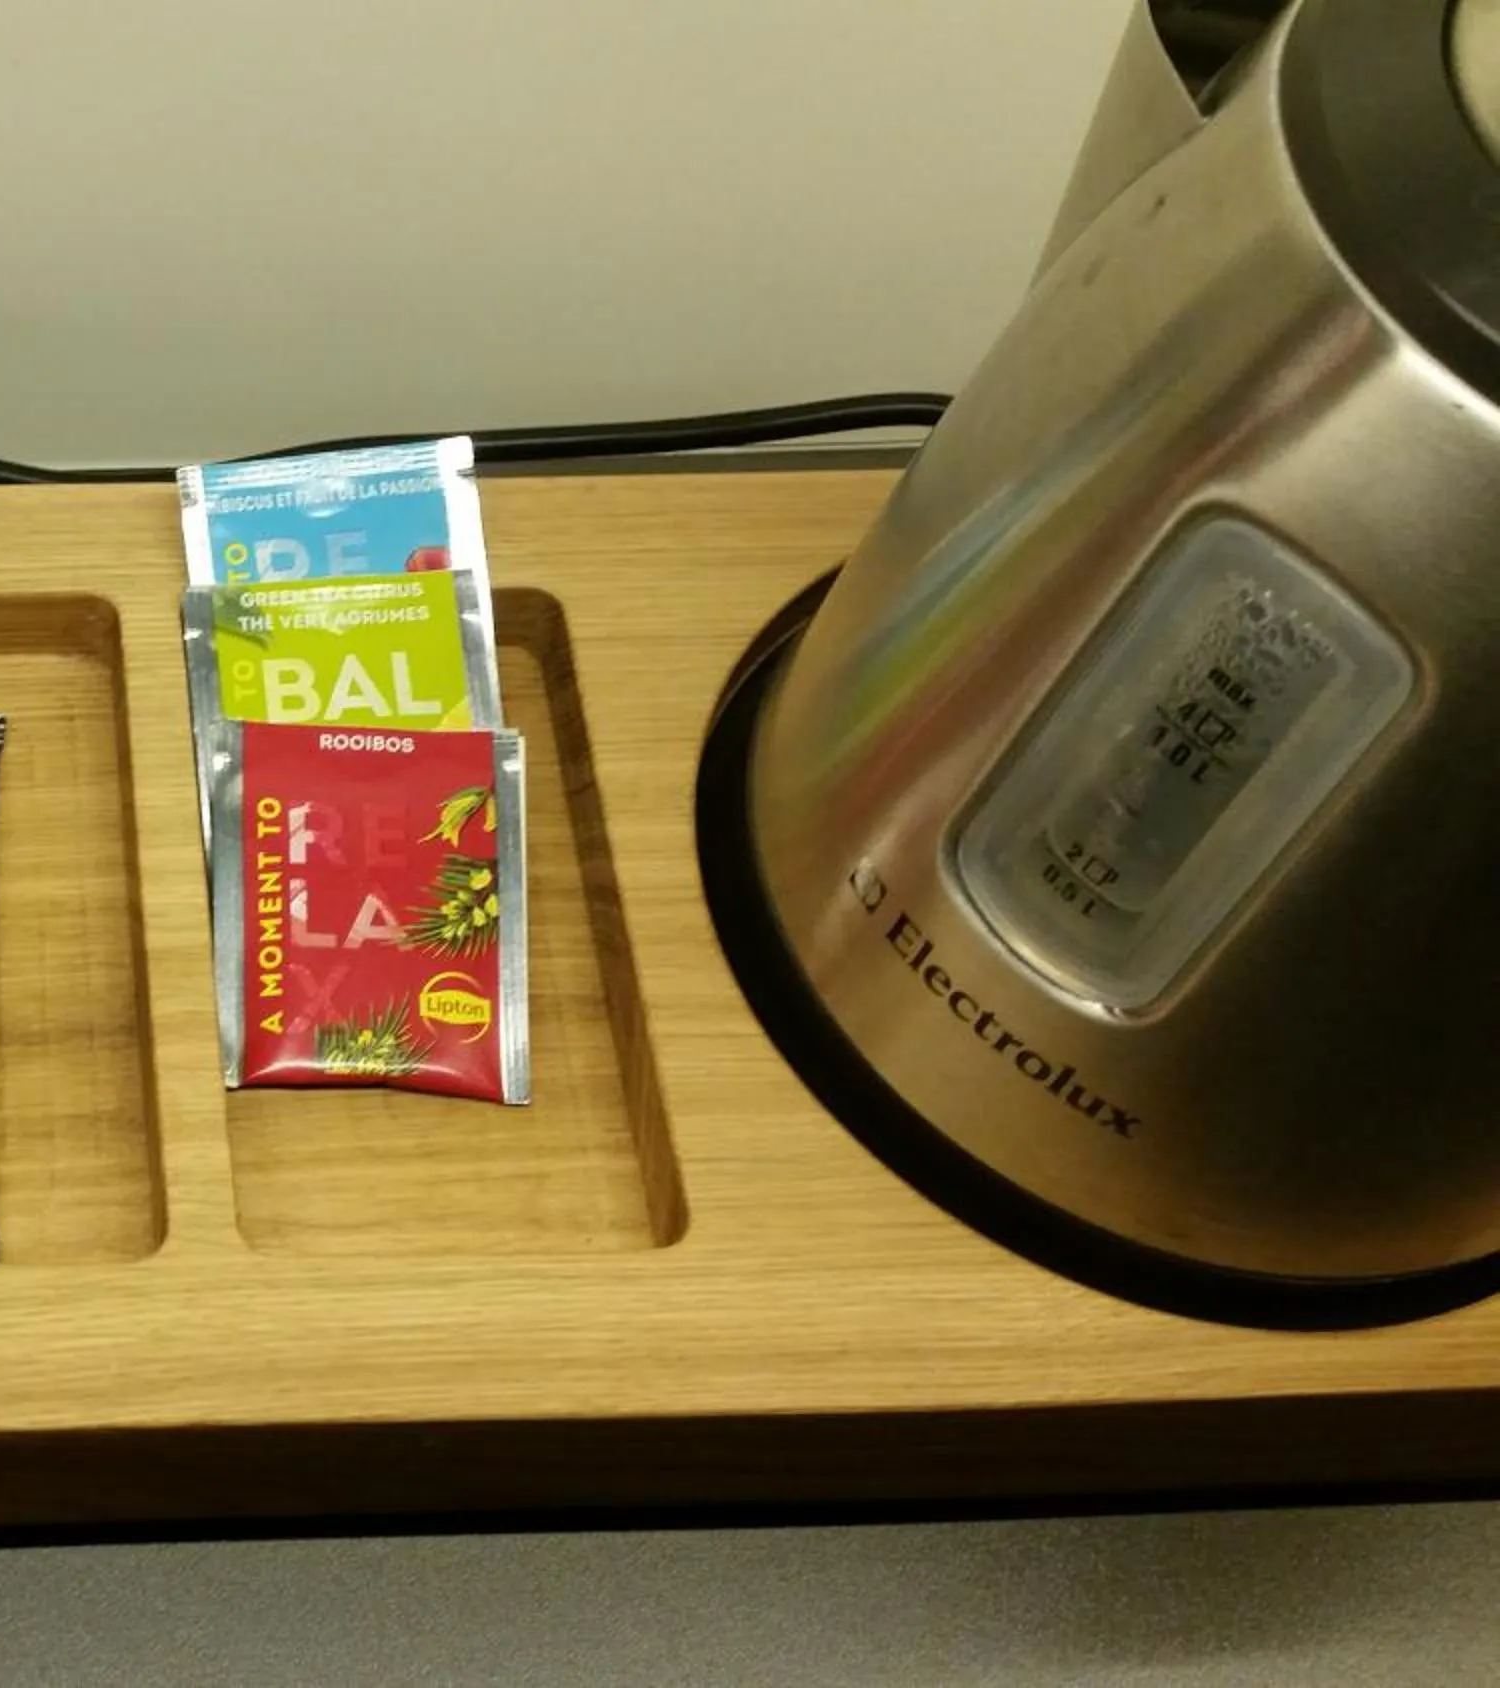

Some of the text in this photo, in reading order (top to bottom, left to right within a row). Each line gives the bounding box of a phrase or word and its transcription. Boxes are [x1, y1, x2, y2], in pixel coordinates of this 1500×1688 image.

[359, 483, 378, 499] LA
[240, 589, 306, 608] GREEN
[333, 605, 431, 628] AGRUMES
[232, 660, 258, 700] TO
[261, 651, 443, 724] BAL
[1206, 666, 1259, 714] max
[1178, 702, 1199, 722] 4
[319, 733, 416, 753] ROOIBOS
[1190, 760, 1211, 785] L
[288, 800, 408, 866] RE
[1065, 841, 1084, 863] 2
[257, 797, 284, 1034] A MOMENT TO
[288, 878, 417, 951] LA
[426, 998, 486, 1018] Lipton
[884, 911, 1144, 1140] Electrolux
